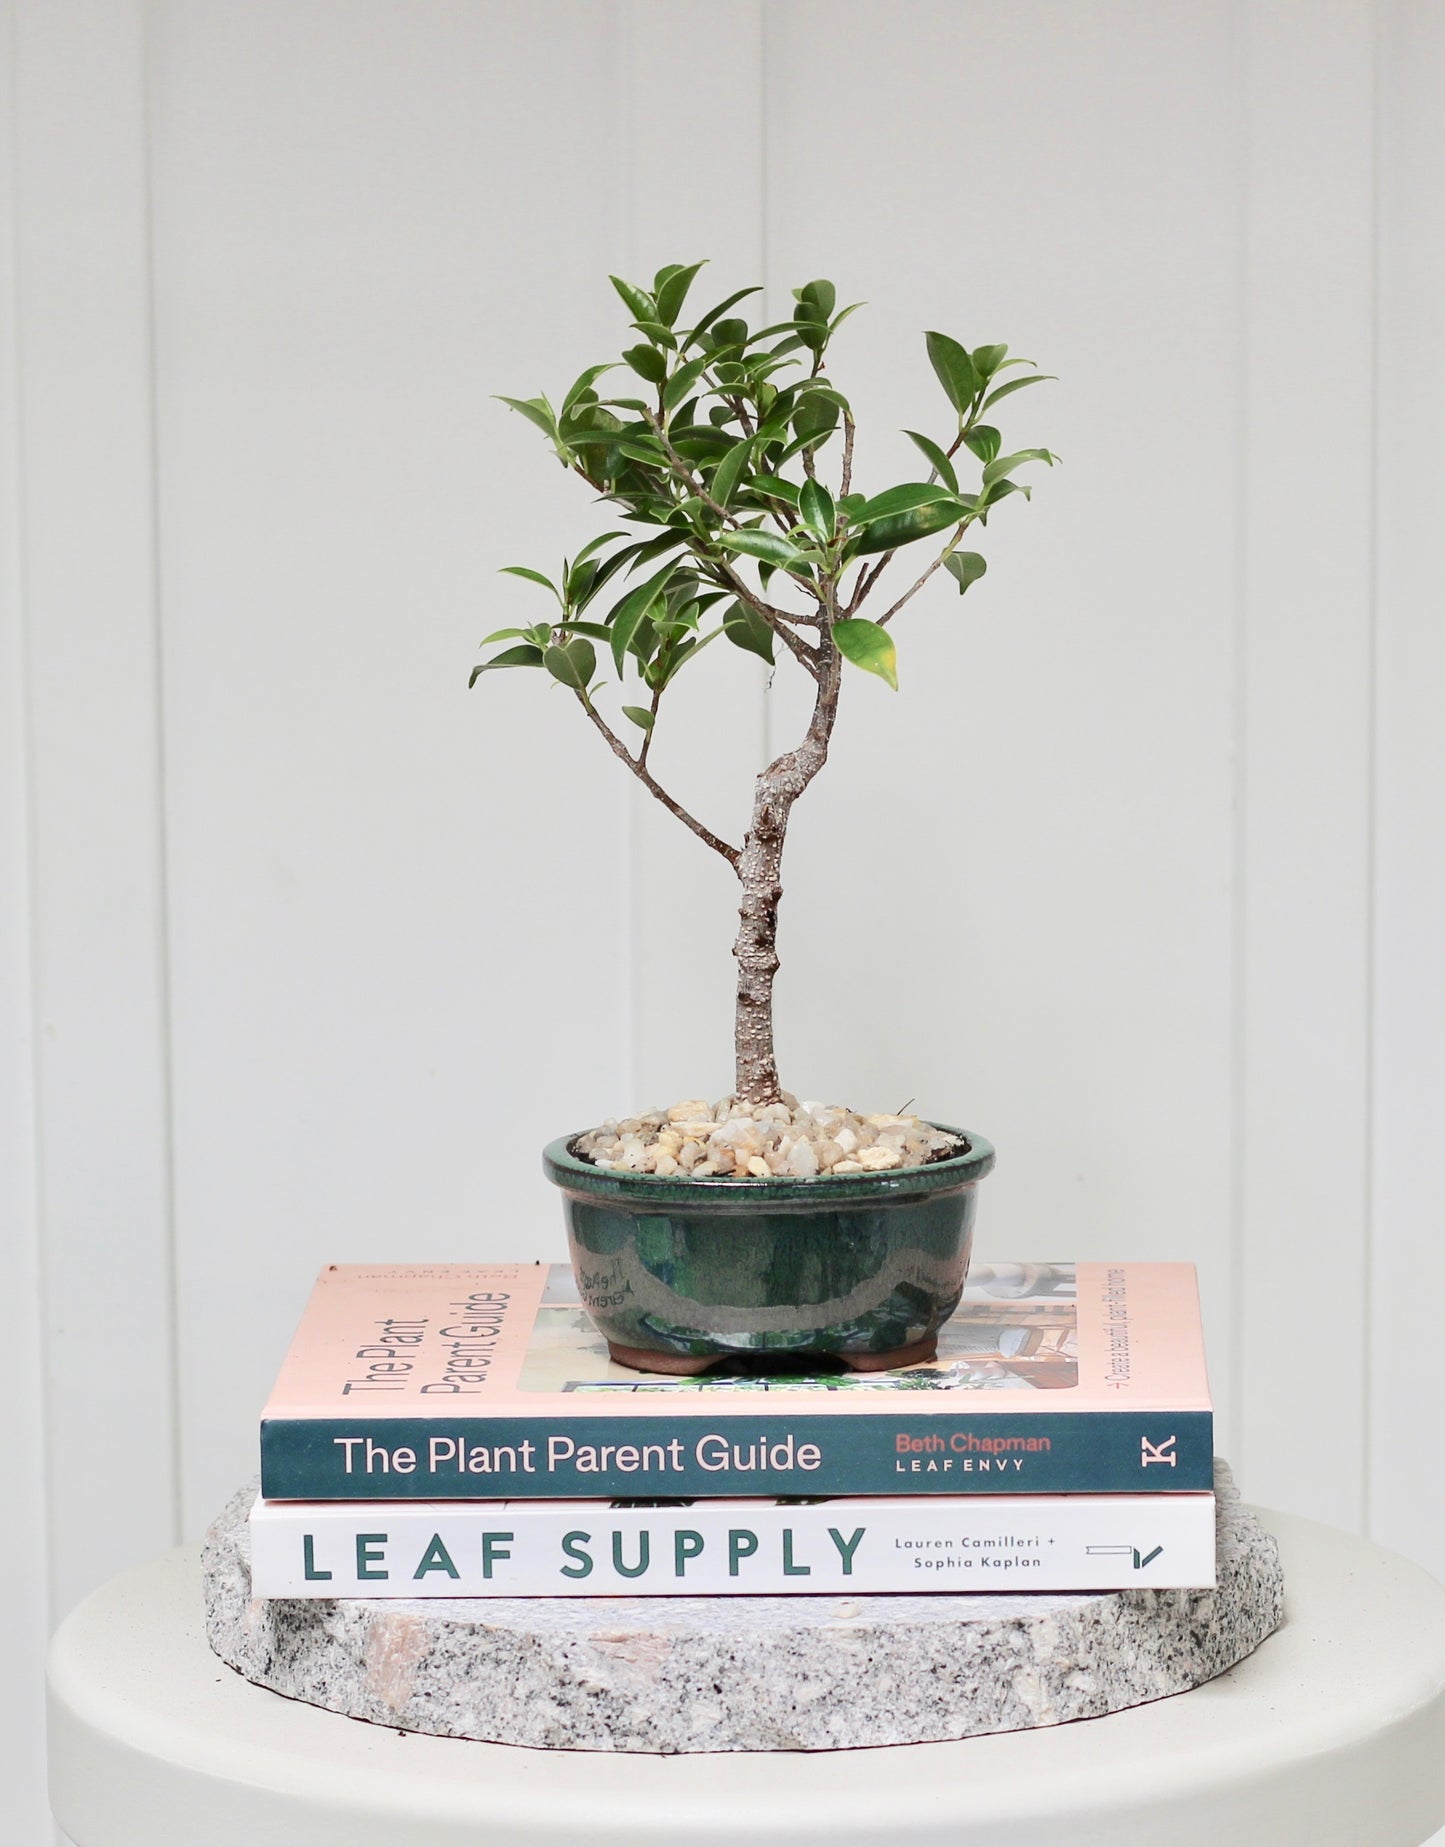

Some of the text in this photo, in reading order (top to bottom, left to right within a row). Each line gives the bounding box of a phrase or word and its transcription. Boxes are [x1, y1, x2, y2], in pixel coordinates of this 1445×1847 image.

[355, 1318, 429, 1359] Plant
[420, 1291, 511, 1394] Parent Guide
[342, 1362, 414, 1396] The
[1104, 1358, 1130, 1381] Create
[334, 1434, 822, 1474] The Plant Parent Guide
[896, 1433, 1051, 1455] Beth Chapman
[1141, 1435, 1176, 1468] K
[896, 1459, 1024, 1472] LEAF ENVY
[303, 1527, 867, 1581] LEAF SUPPLY
[895, 1538, 953, 1549] Lauren
[961, 1536, 1039, 1548] Camilleri
[914, 1556, 1041, 1571] Sophia Kaplan
